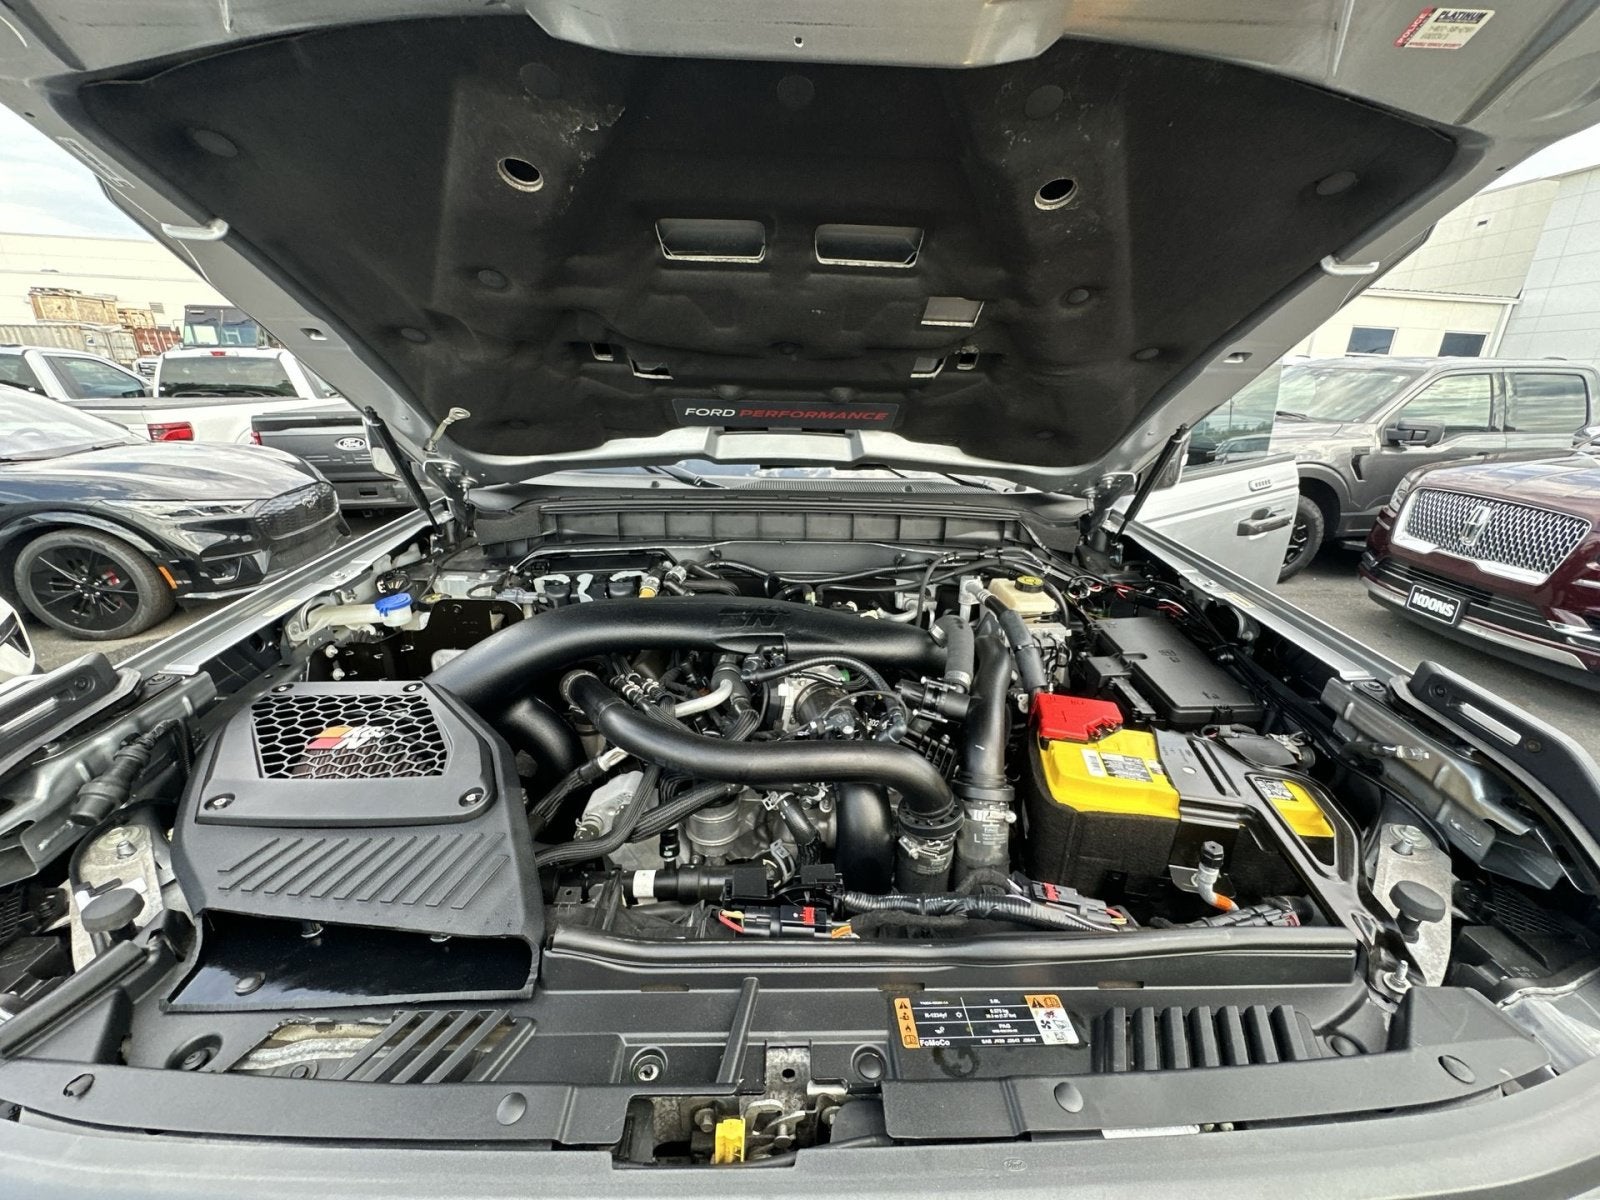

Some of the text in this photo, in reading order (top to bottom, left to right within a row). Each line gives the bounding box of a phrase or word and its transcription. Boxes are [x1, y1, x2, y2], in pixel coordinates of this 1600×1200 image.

[1438, 11, 1488, 21] PLATINUM
[684, 407, 889, 421] FORD PERFORMANCE
[1412, 592, 1455, 617] KOONS
[919, 1039, 950, 1047] FoMoCo
